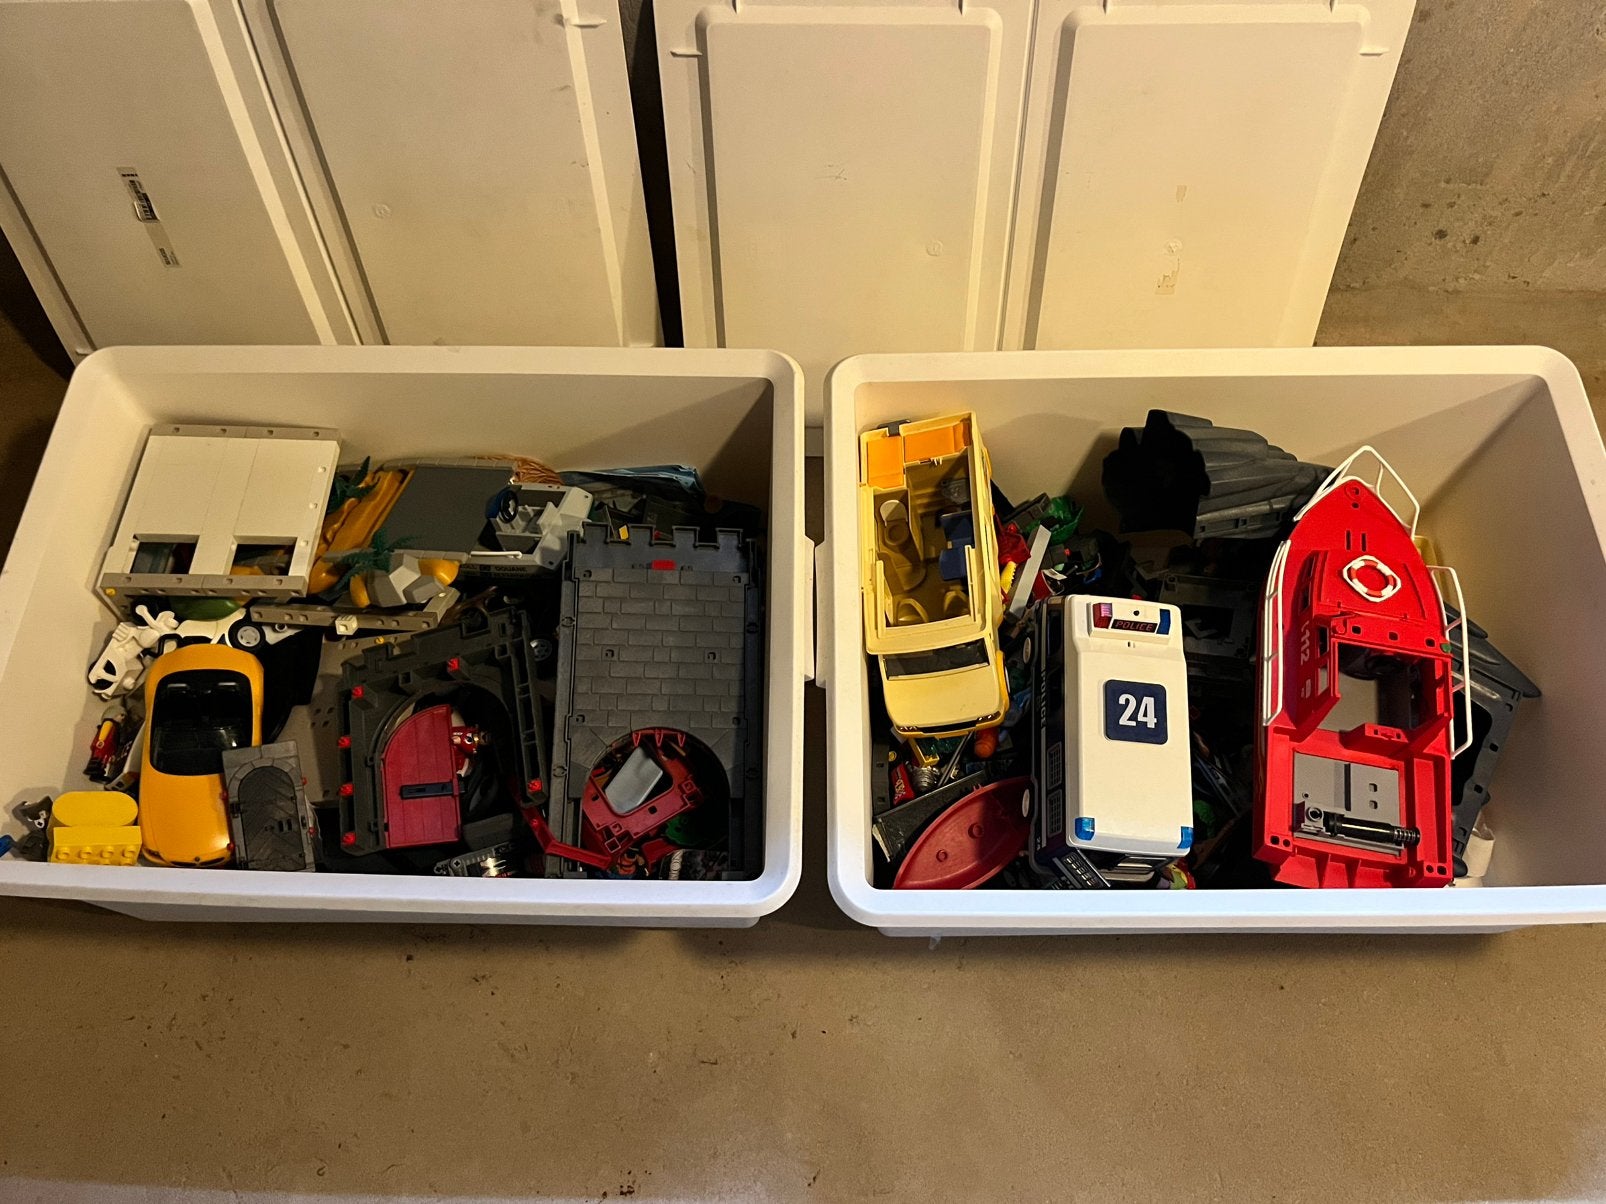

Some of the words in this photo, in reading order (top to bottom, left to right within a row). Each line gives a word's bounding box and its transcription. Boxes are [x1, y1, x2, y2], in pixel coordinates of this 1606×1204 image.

[1115, 620, 1154, 632] POLICE
[1300, 629, 1311, 666] 112
[1118, 693, 1157, 729] 24
